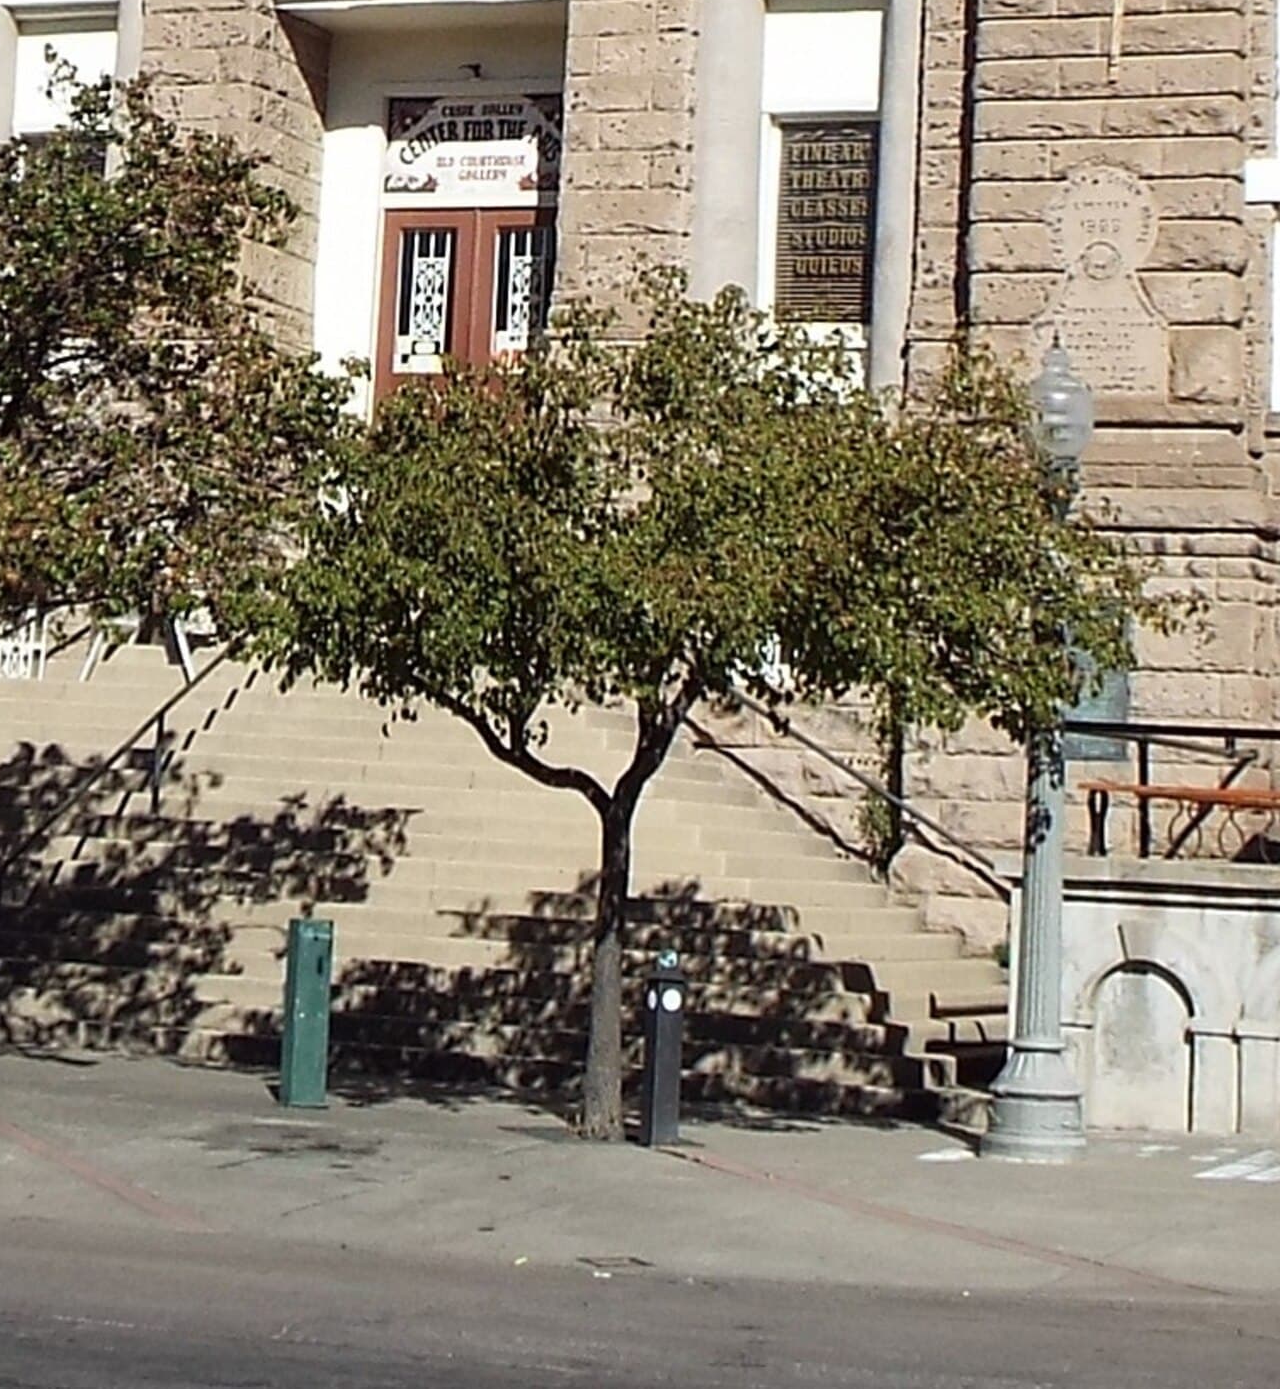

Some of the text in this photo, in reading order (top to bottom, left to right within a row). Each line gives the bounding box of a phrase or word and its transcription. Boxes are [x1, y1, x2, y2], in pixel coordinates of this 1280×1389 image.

[399, 120, 458, 165] CENTER
[463, 119, 495, 141] FOR
[497, 118, 527, 139] THE
[458, 168, 507, 181] GALLERY
